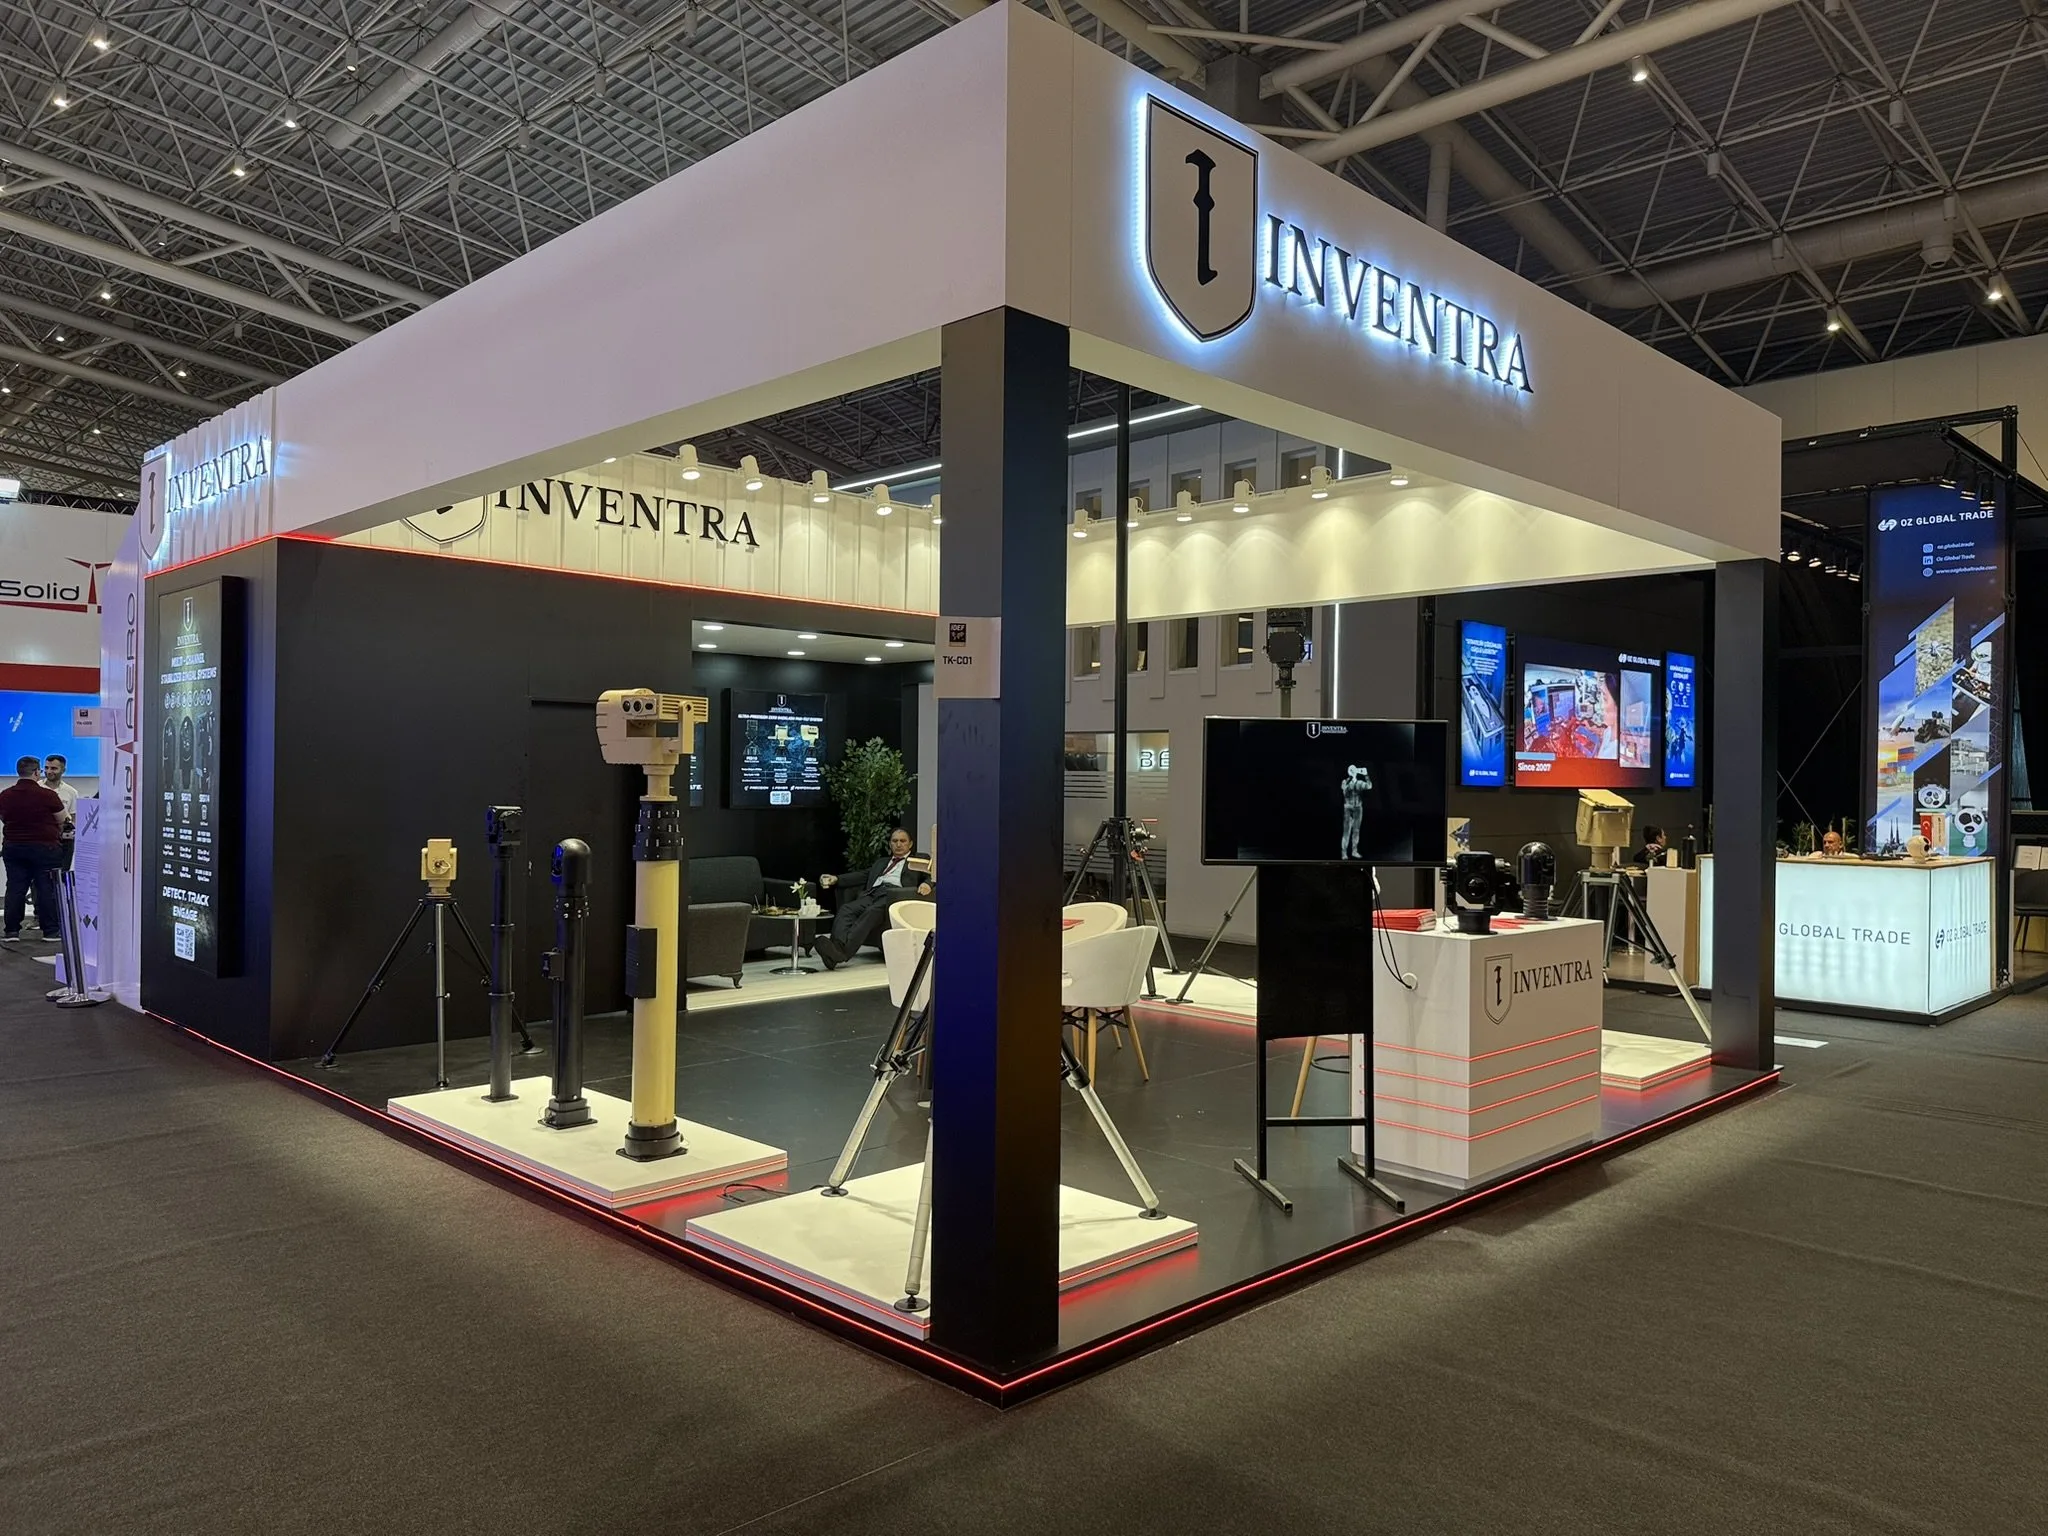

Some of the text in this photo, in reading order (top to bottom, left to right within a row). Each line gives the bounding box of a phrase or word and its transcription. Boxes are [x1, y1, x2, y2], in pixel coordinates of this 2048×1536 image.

[1264, 214, 1534, 394] INVENTRA
[166, 434, 268, 514] INVENTRA
[494, 478, 760, 547] INVENTRA
[1900, 509, 1994, 527] OZ GLOBAL TRADE
[0, 580, 79, 601] Solid
[942, 655, 972, 665] TK-C01
[1517, 762, 1551, 772] Since 2007
[123, 765, 133, 873] Solid
[187, 891, 210, 907] TRACK
[1779, 922, 1911, 945] GLOBAL TRADE
[1513, 959, 1593, 994] INVENTRA
